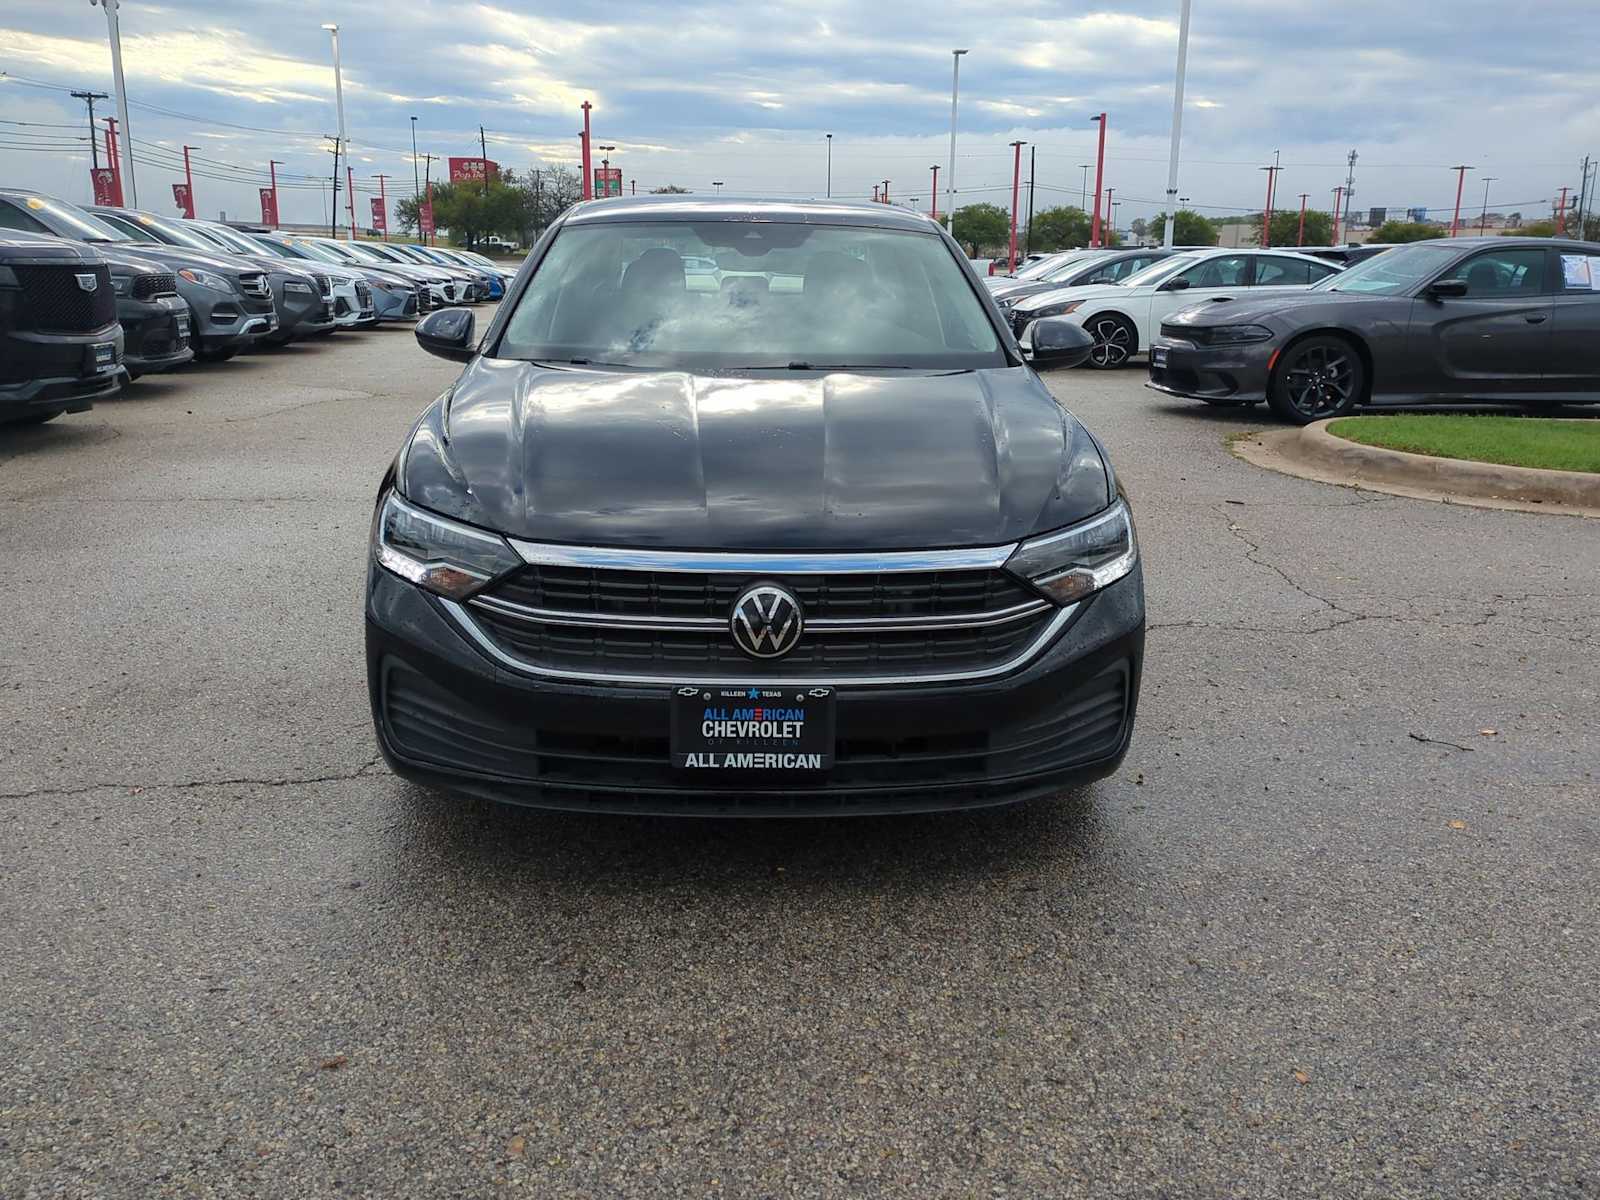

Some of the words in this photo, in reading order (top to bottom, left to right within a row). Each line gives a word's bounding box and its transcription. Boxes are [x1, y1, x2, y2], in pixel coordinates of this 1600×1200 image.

[762, 690, 782, 698] TEXAS
[704, 708, 729, 721] ALL
[732, 708, 804, 721] AMERICAN
[702, 721, 804, 738] CHEVROLET
[685, 753, 720, 768] ALL
[723, 753, 821, 769] AMERICAN
